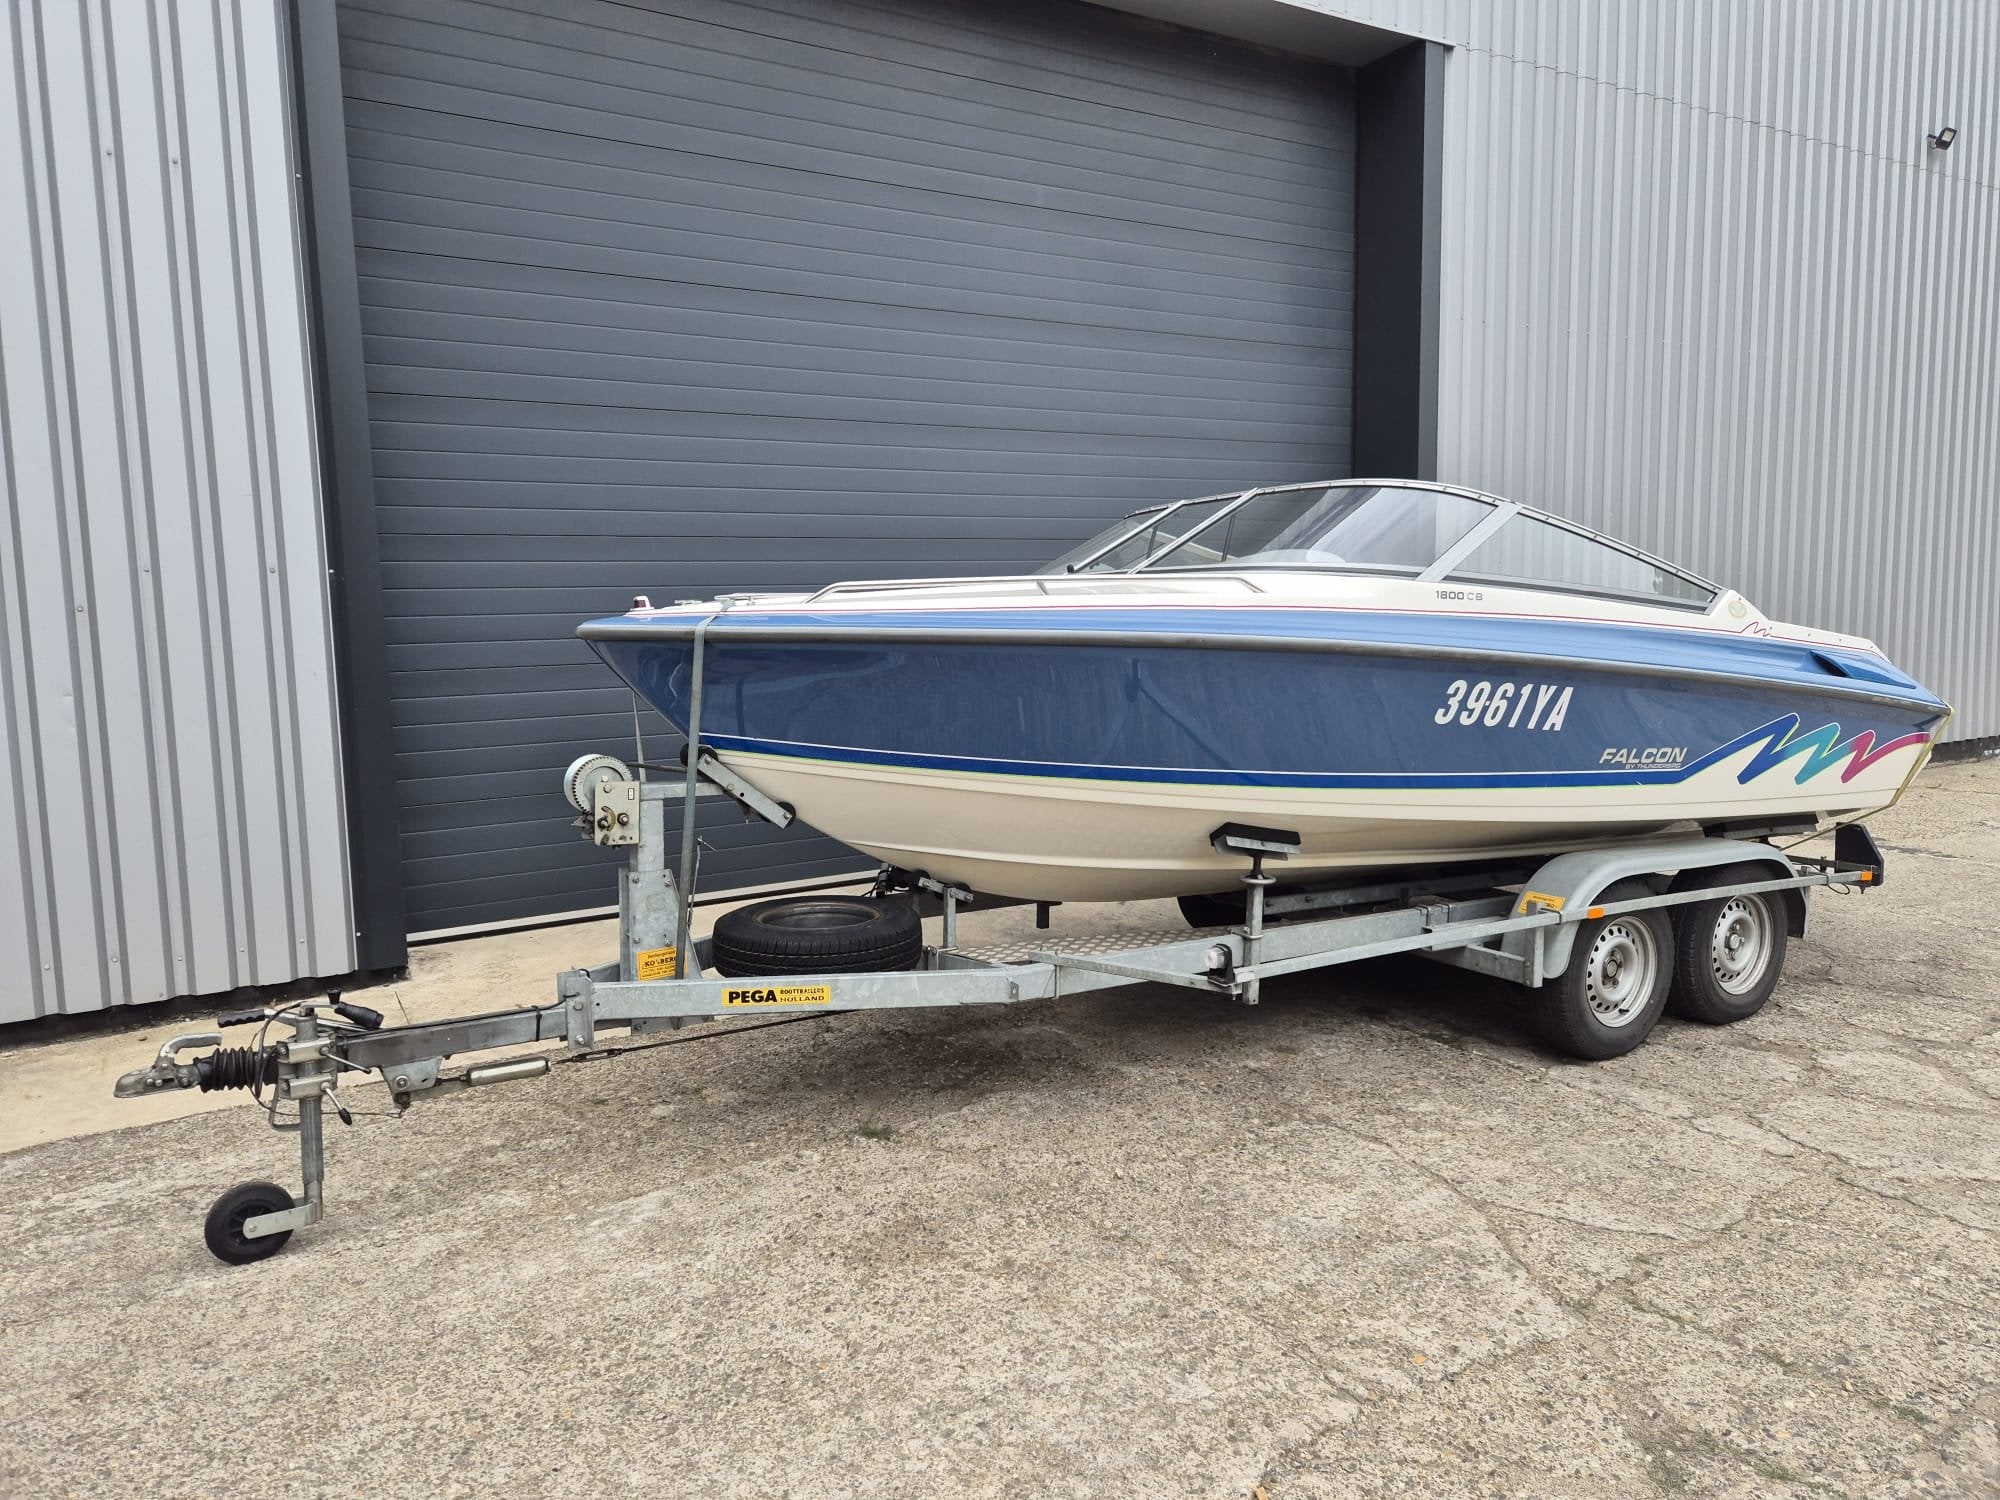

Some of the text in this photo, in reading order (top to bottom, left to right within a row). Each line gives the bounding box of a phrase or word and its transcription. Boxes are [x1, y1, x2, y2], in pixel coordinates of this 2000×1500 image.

[1435, 590, 1465, 600] 1800
[1599, 746, 1688, 764] FALCON
[728, 989, 778, 1004] PEGA
[780, 995, 825, 1003] HOLLAND
